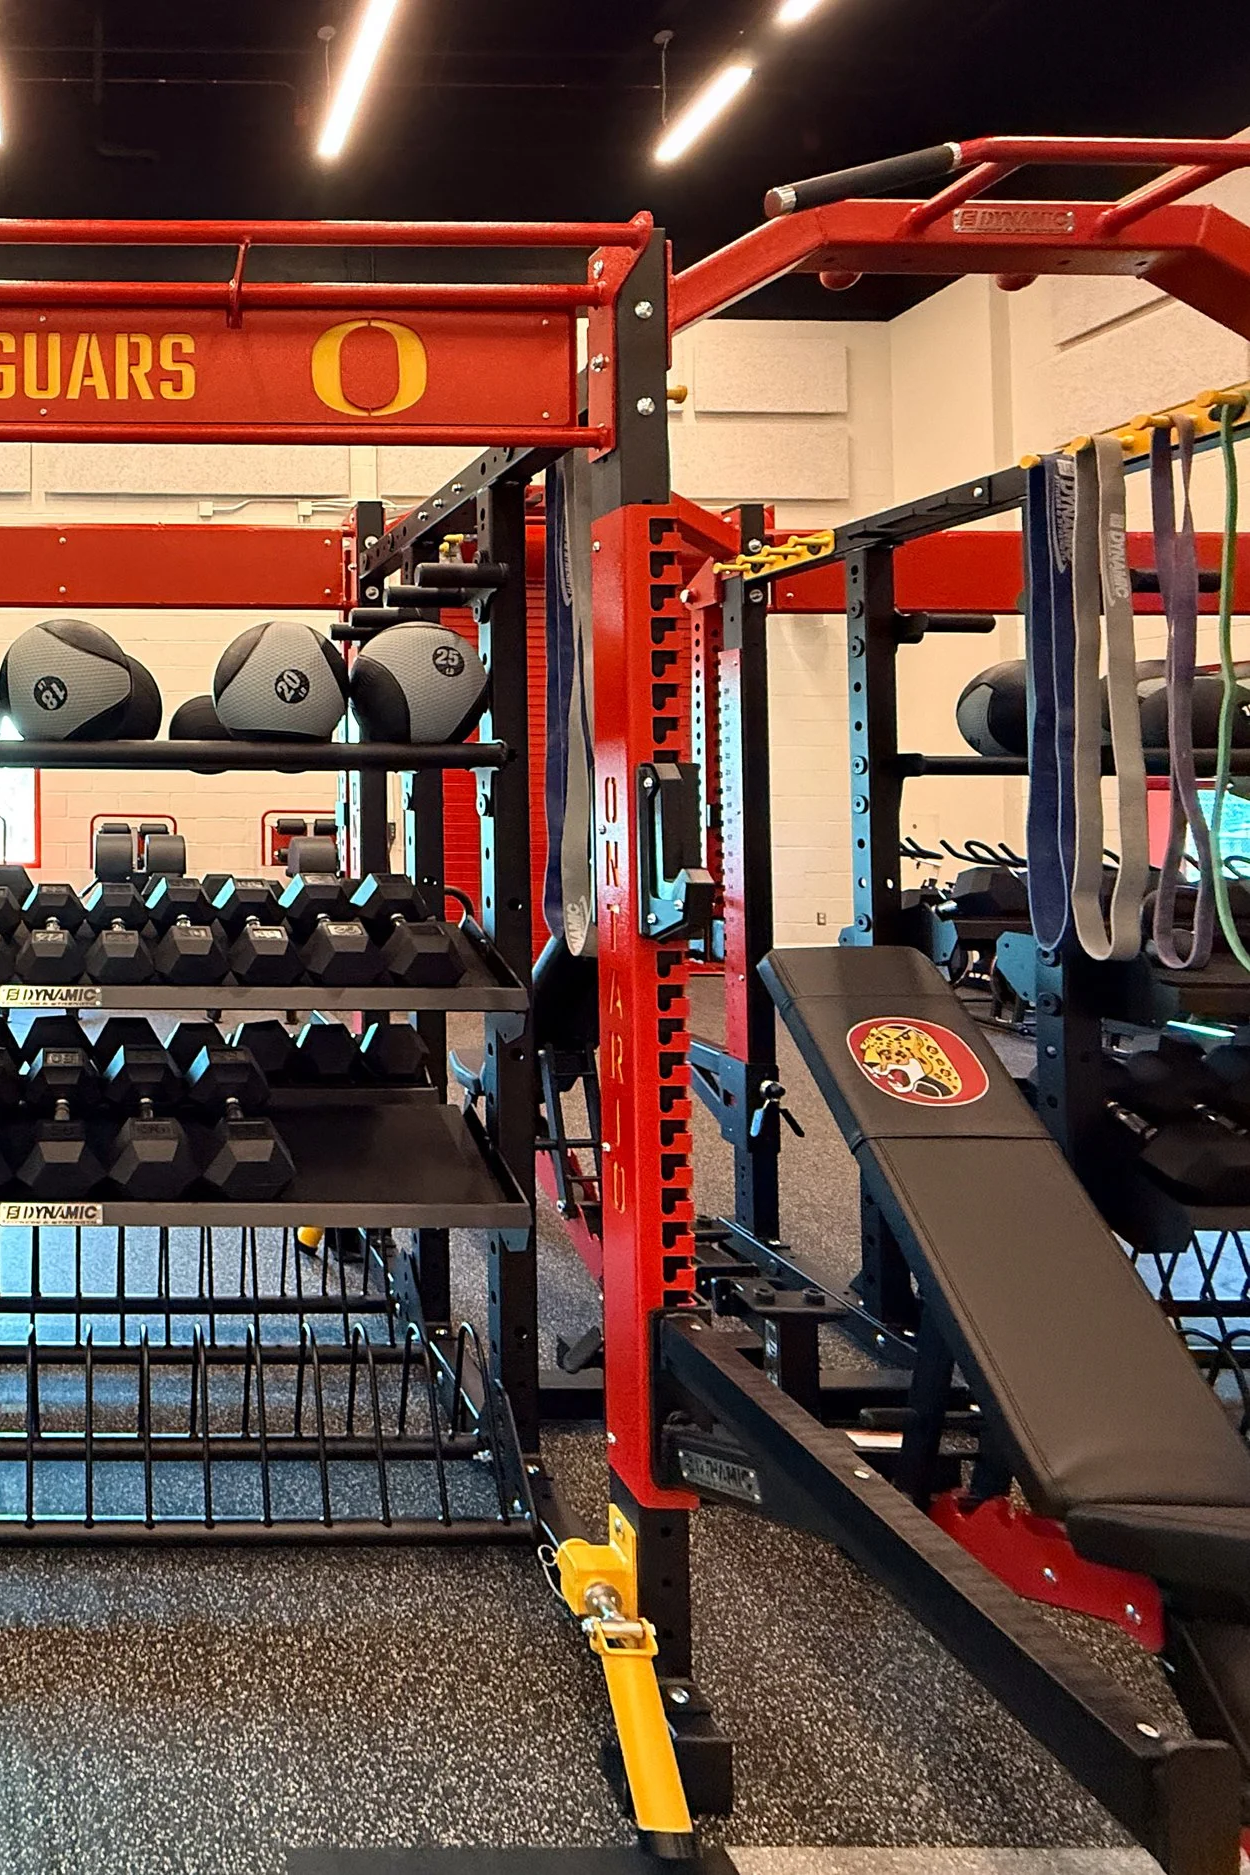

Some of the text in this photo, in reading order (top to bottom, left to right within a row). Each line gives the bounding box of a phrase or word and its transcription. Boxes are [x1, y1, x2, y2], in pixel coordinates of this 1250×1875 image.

[311, 319, 427, 416] O
[1108, 530, 1130, 599] DYNAMIC
[435, 649, 459, 666] 25
[41, 682, 65, 710] 18
[277, 670, 301, 702] 20
[23, 988, 97, 1001] DYNAMIC
[604, 776, 626, 1214] ONTARIO
[23, 1205, 98, 1219] DYNAMIC
